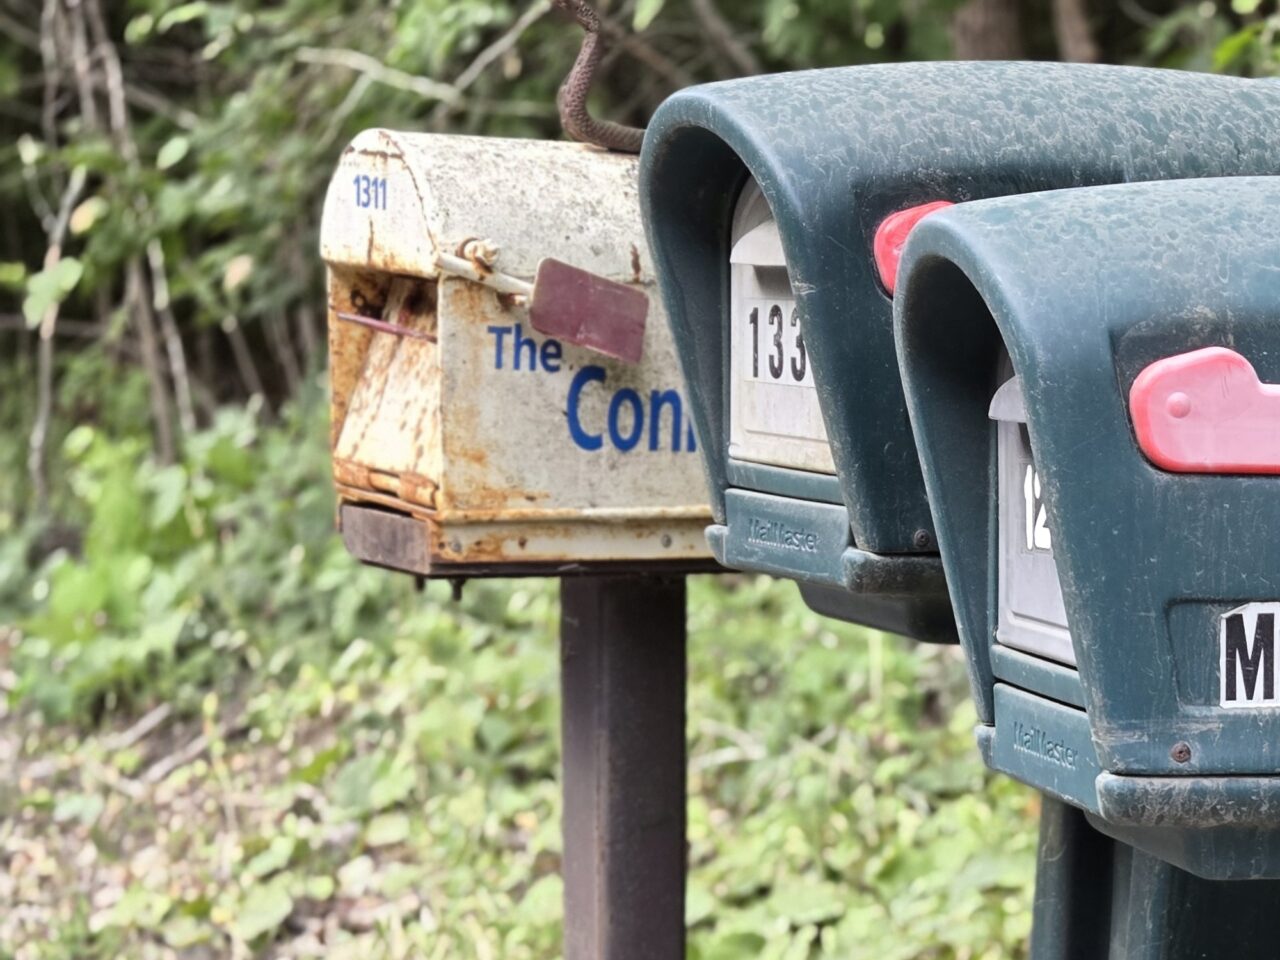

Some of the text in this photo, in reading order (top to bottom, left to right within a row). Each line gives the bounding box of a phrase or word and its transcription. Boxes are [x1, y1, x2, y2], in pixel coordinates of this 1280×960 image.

[353, 175, 387, 211] 1311
[487, 323, 562, 373] The
[749, 304, 806, 382] 133
[747, 517, 818, 554] MailMaster
[1013, 721, 1079, 770] MailMaster
